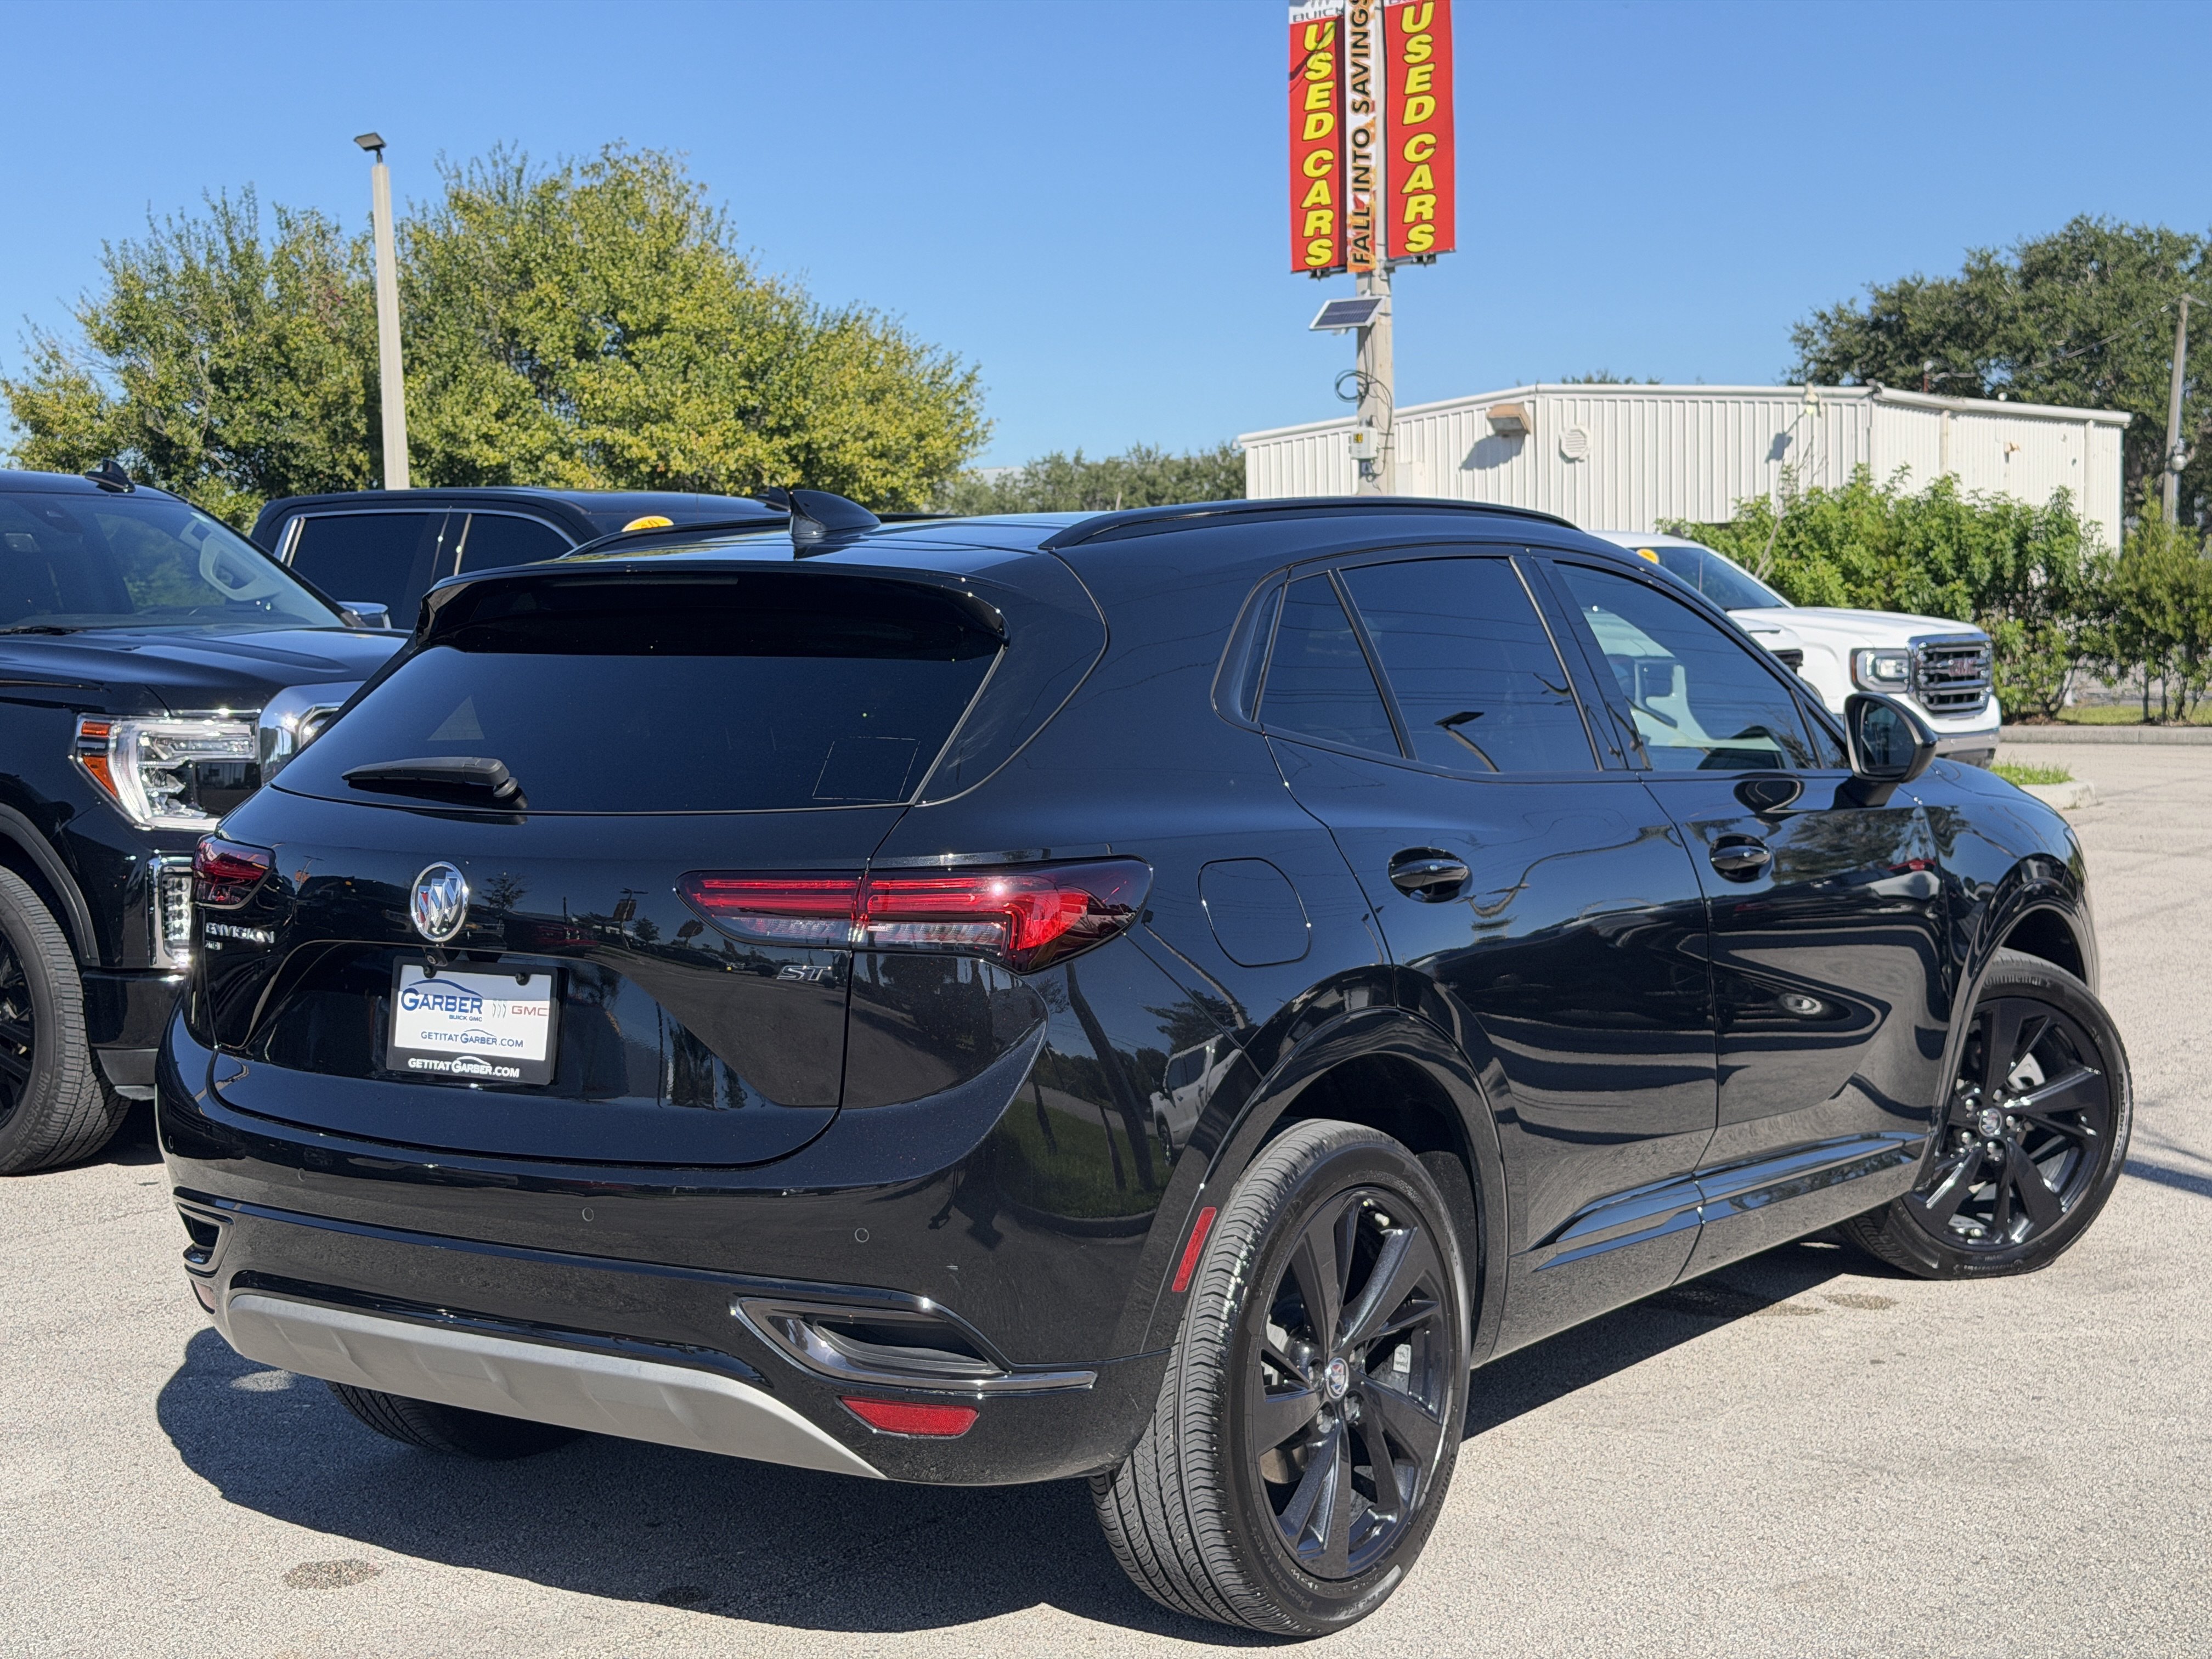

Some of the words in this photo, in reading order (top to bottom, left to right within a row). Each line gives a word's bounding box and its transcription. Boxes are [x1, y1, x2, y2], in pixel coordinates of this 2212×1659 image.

[1303, 21, 1335, 142] USED
[1401, 2, 1436, 126] USED
[1352, 128, 1371, 193] INTO
[1300, 148, 1335, 267] CARS
[1401, 132, 1437, 253] CARS
[1353, 204, 1371, 264] FALL
[401, 988, 483, 1014] GARBER
[777, 966, 832, 981] ST
[421, 1031, 523, 1048] GETITATGARBER.COM
[511, 1006, 549, 1017] GMC
[408, 1058, 520, 1078] GETITATGARBER.COM
